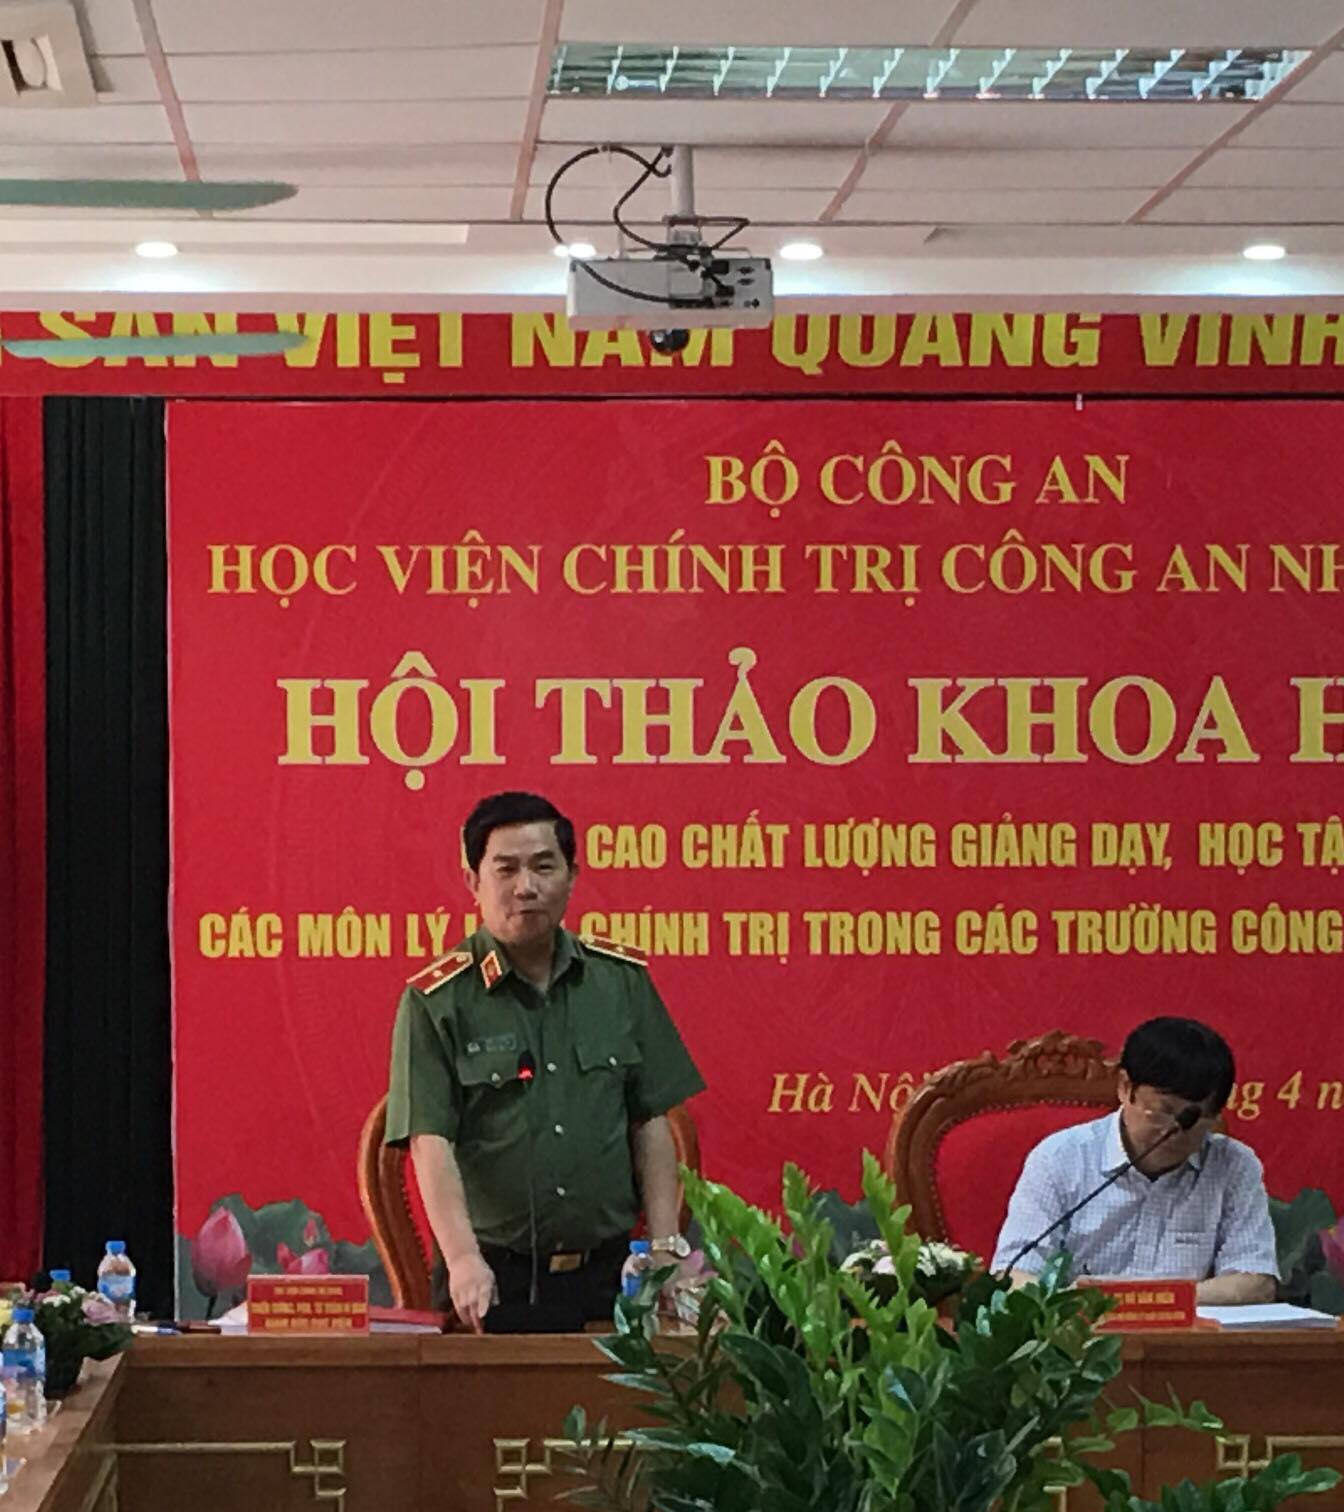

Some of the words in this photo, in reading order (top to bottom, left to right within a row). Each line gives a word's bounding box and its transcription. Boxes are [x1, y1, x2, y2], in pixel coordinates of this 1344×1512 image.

[772, 312, 1102, 375] QUANG
[704, 440, 799, 517] BỘ
[819, 439, 1015, 504] CÔNG
[1035, 455, 1129, 504] AN
[207, 544, 357, 608] HỌC
[376, 529, 541, 608] VIỆN
[562, 528, 786, 594] CHÍNH
[805, 544, 920, 606] TRỊ
[941, 528, 1136, 594] CÔNG
[1155, 544, 1250, 593] AN
[276, 650, 506, 791] HỘI
[534, 646, 878, 766] THẢO
[906, 675, 1262, 766] KHOA
[585, 823, 668, 869] CAO
[680, 809, 791, 869] CHẤT
[802, 816, 937, 876] LƯỢNG
[950, 812, 1078, 869] GIẢNG
[1090, 822, 1174, 874] DẠY,
[1198, 822, 1285, 875] HỌC
[198, 908, 283, 959] CÁC
[296, 906, 392, 958] MÔN
[405, 906, 451, 957] LÝ
[580, 904, 711, 957] CHÍNH
[721, 911, 791, 965] TRỊ
[803, 910, 942, 956] TRONG
[954, 903, 1039, 956] CÁC
[1050, 901, 1218, 956] TRƯỜNG
[1230, 902, 1344, 955] CÔNG
[767, 1072, 834, 1112] Hà
[1276, 1071, 1303, 1110] 4
